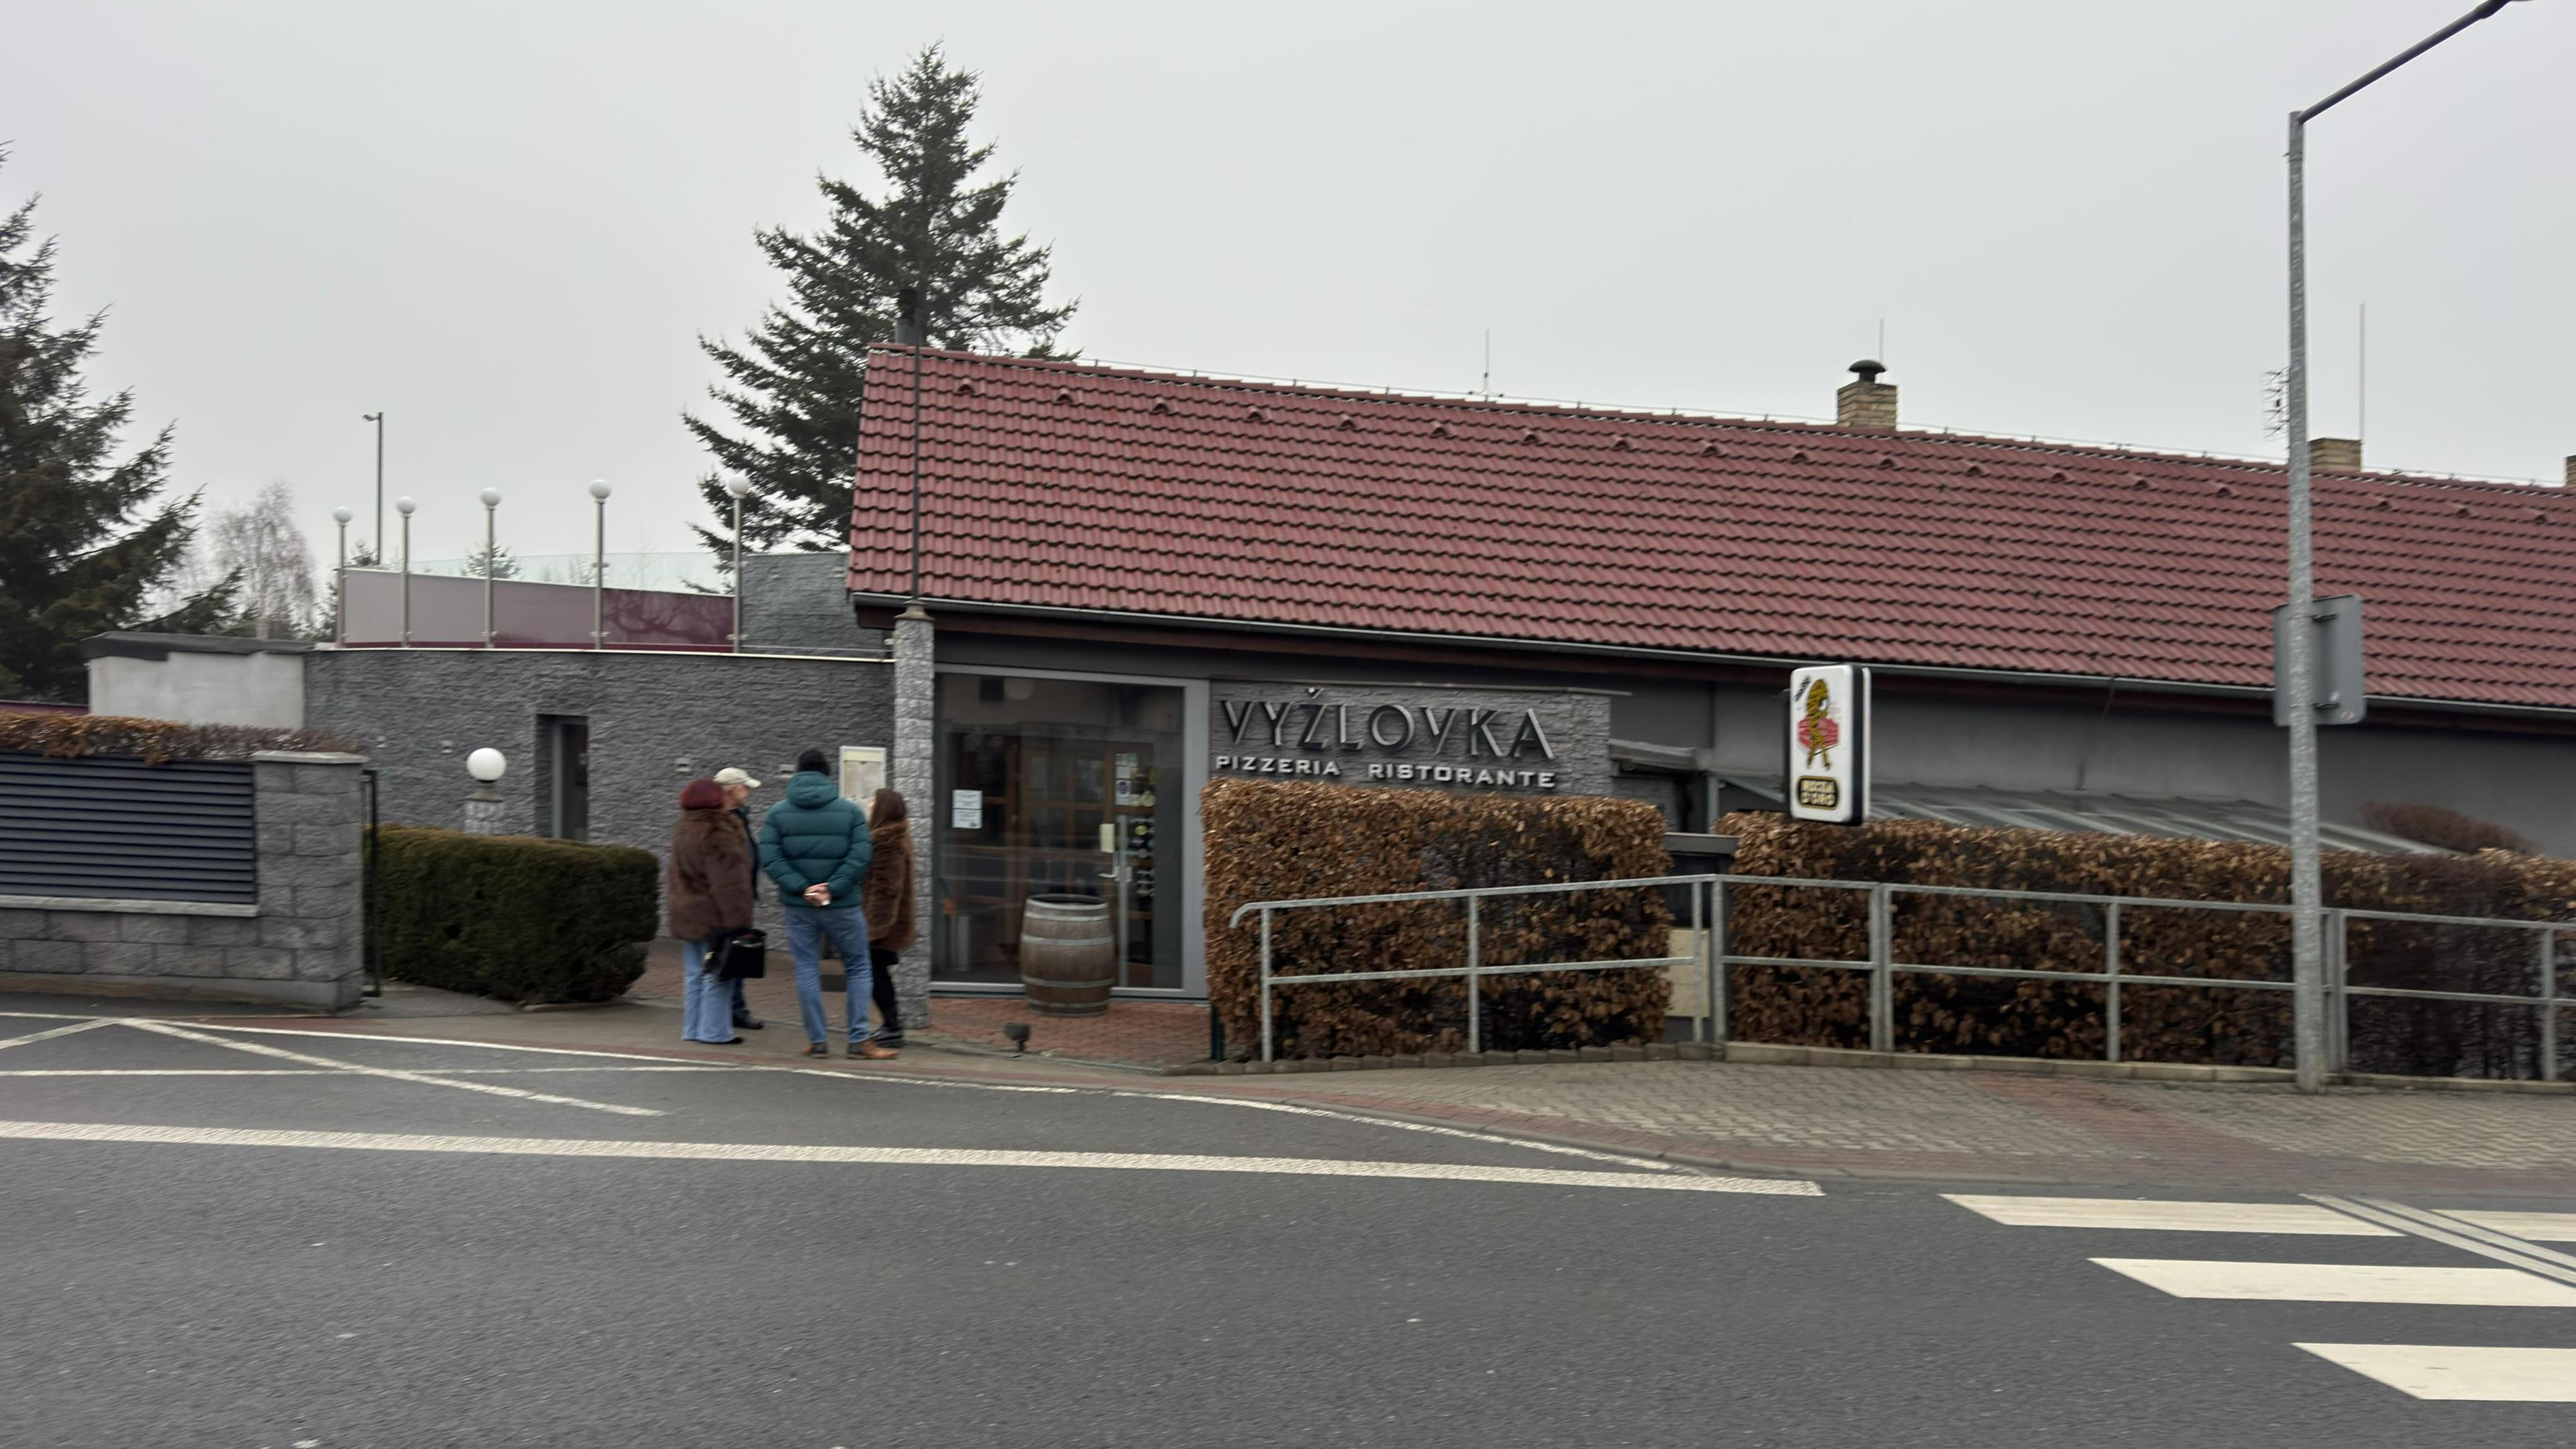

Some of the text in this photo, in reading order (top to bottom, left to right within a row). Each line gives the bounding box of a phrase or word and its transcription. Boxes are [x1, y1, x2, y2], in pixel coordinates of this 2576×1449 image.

[1221, 687, 1555, 759] VYŽLOVKA
[1215, 755, 1555, 788] PIZZERIA RISTORANTE
